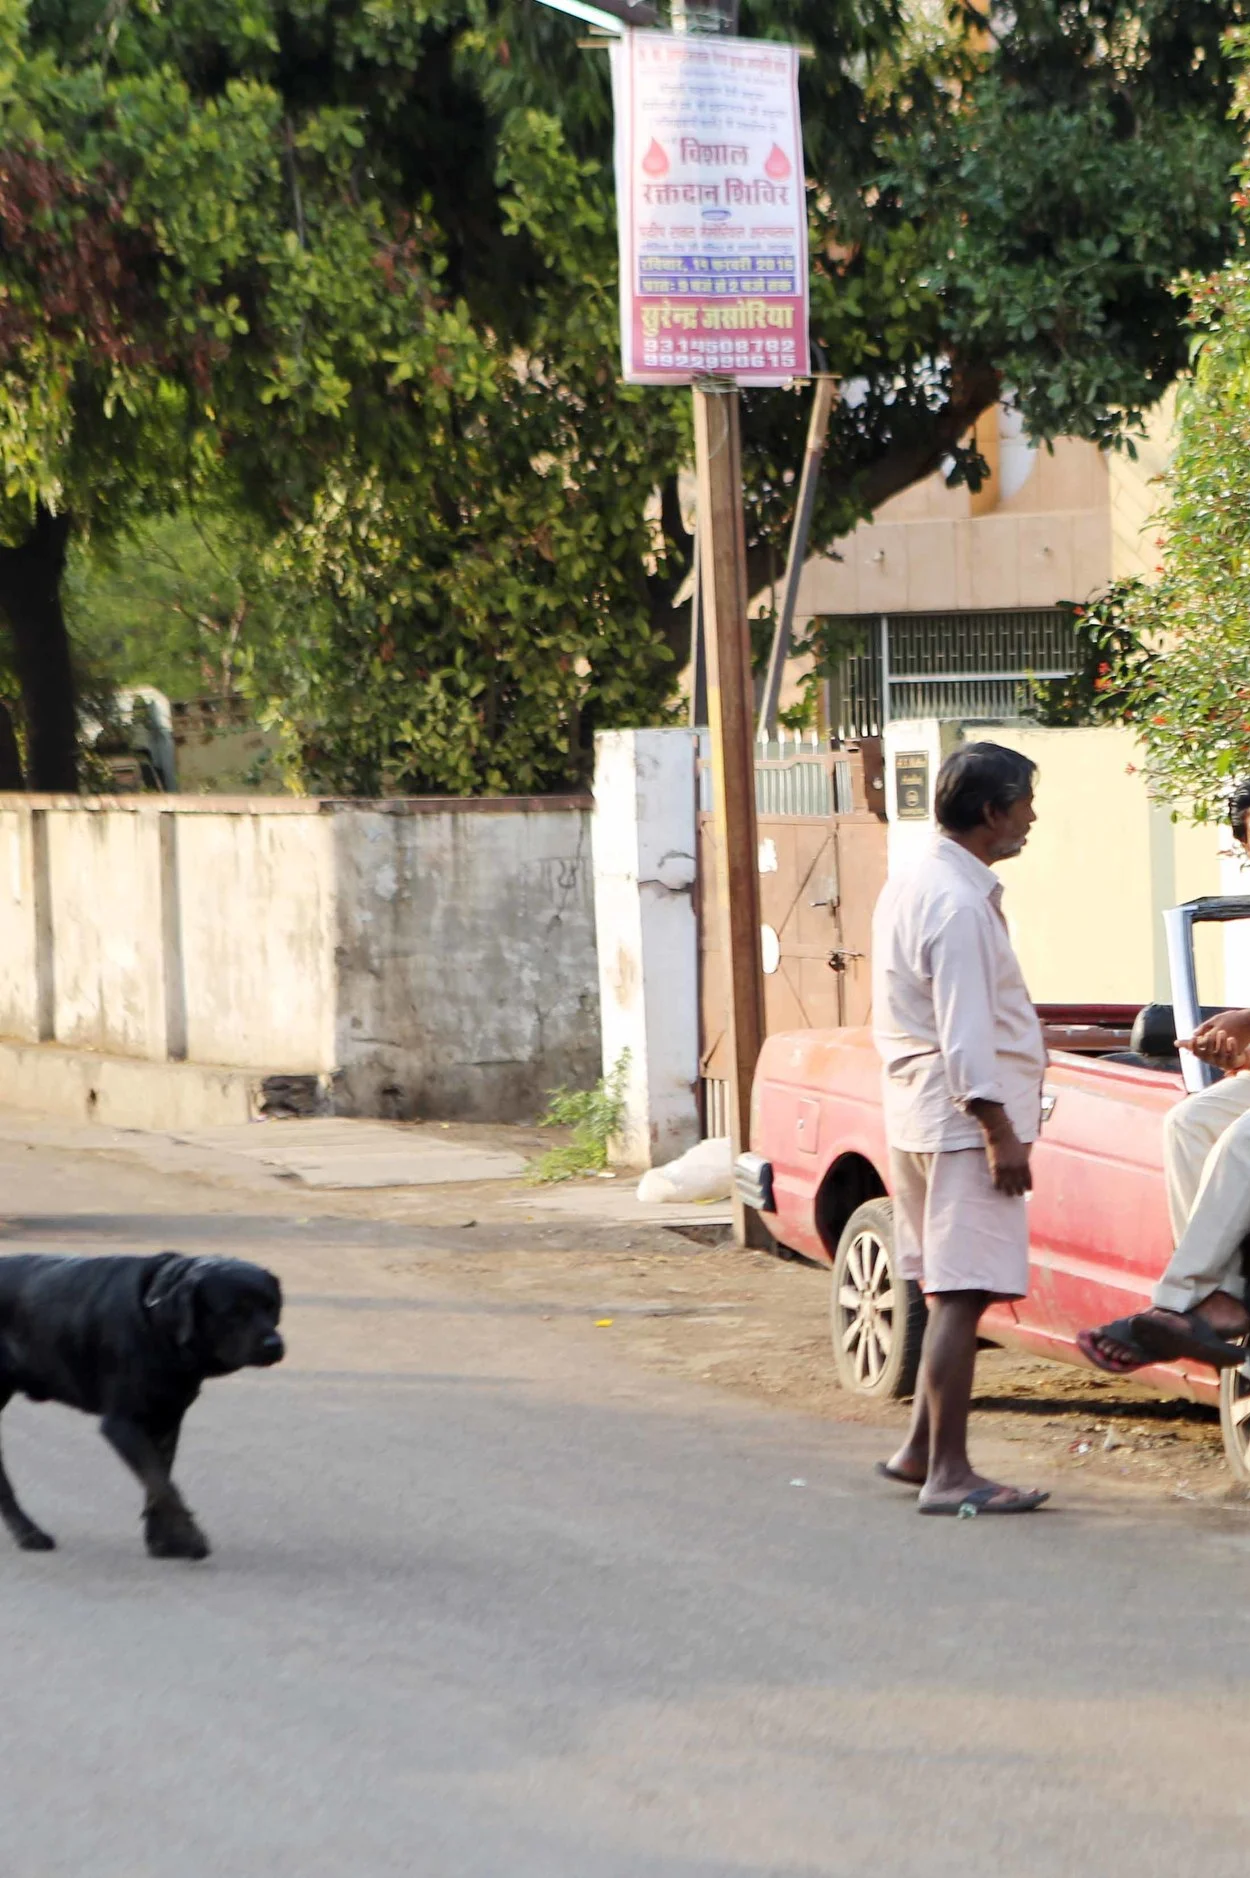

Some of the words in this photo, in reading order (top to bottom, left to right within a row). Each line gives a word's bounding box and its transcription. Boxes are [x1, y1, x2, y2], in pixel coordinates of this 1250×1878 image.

[680, 136, 749, 166] विशाल
[642, 183, 720, 206] रक्तदान
[724, 177, 790, 205] शिविर
